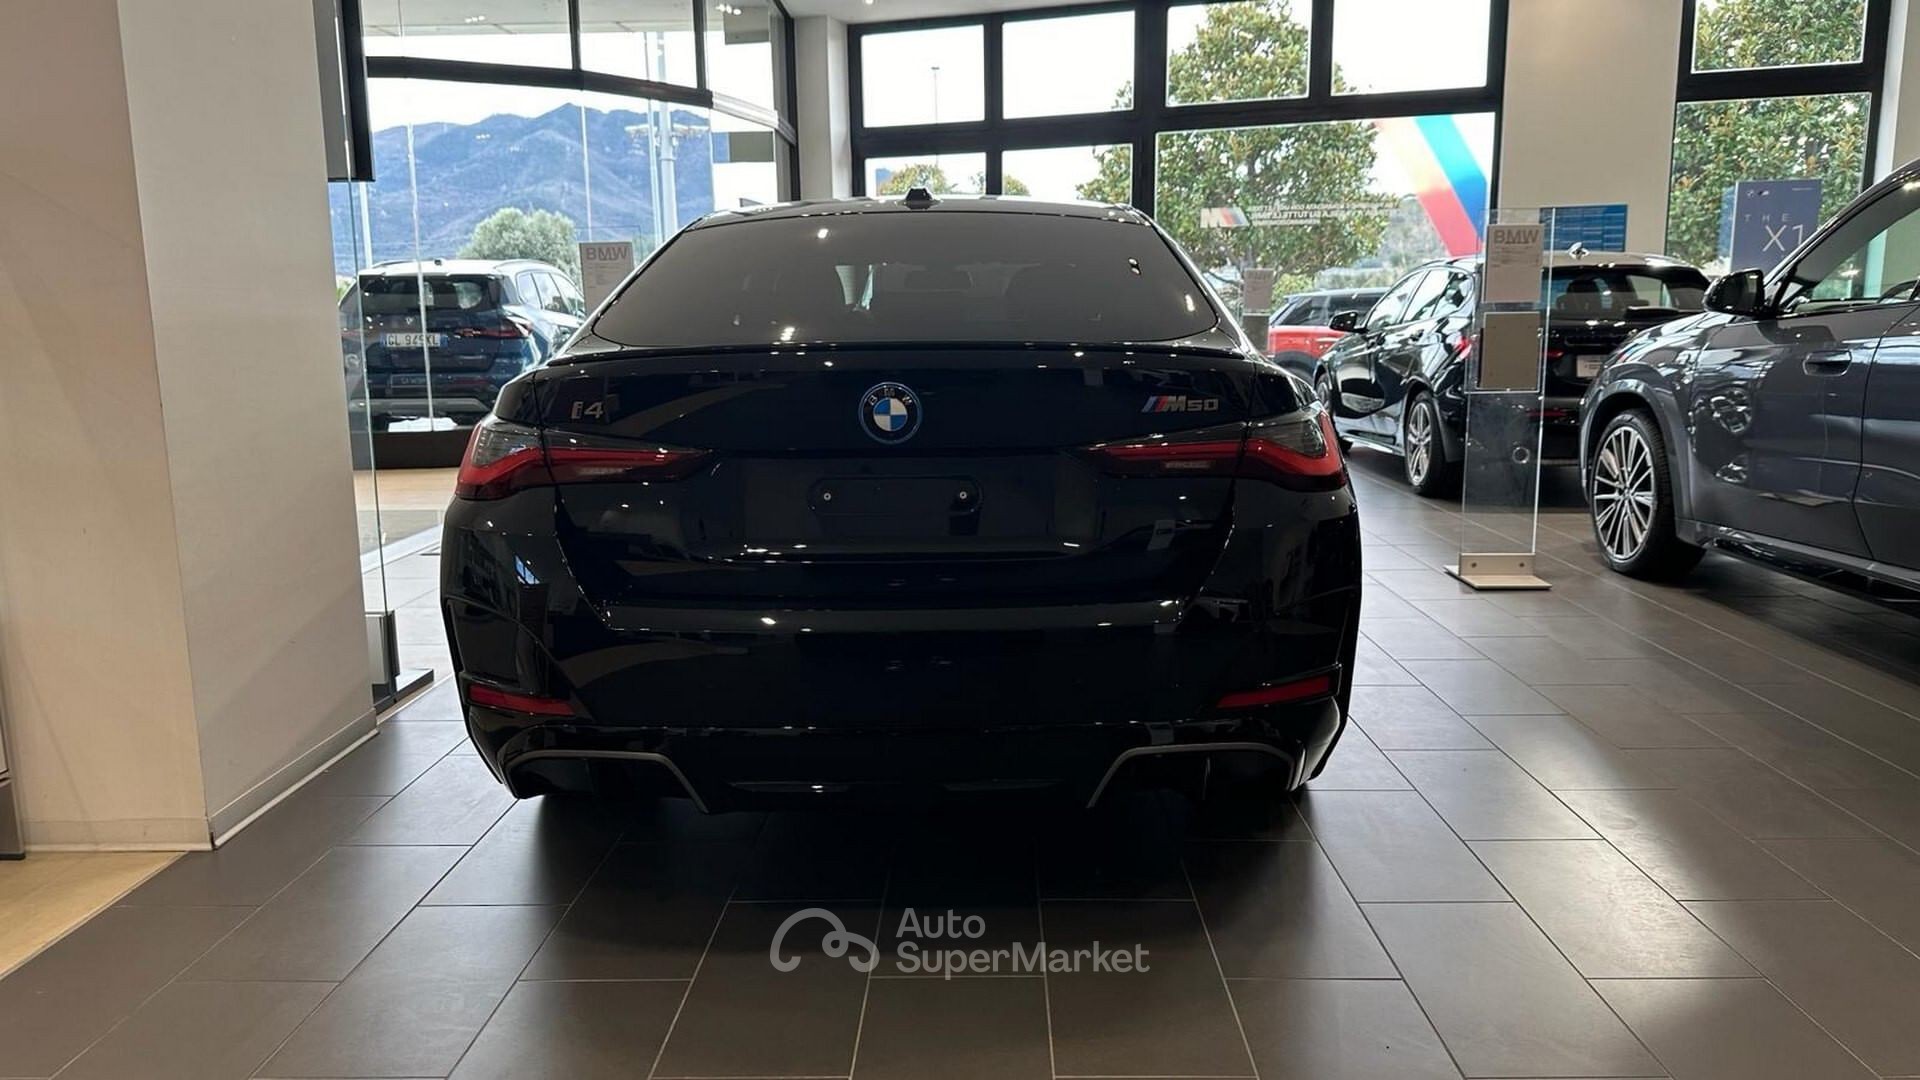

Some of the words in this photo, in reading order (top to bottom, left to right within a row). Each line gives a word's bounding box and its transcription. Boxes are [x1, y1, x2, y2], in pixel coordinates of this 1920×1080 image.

[1494, 229, 1539, 244] BMW
[1762, 224, 1804, 252] X1
[586, 246, 628, 261] BMW
